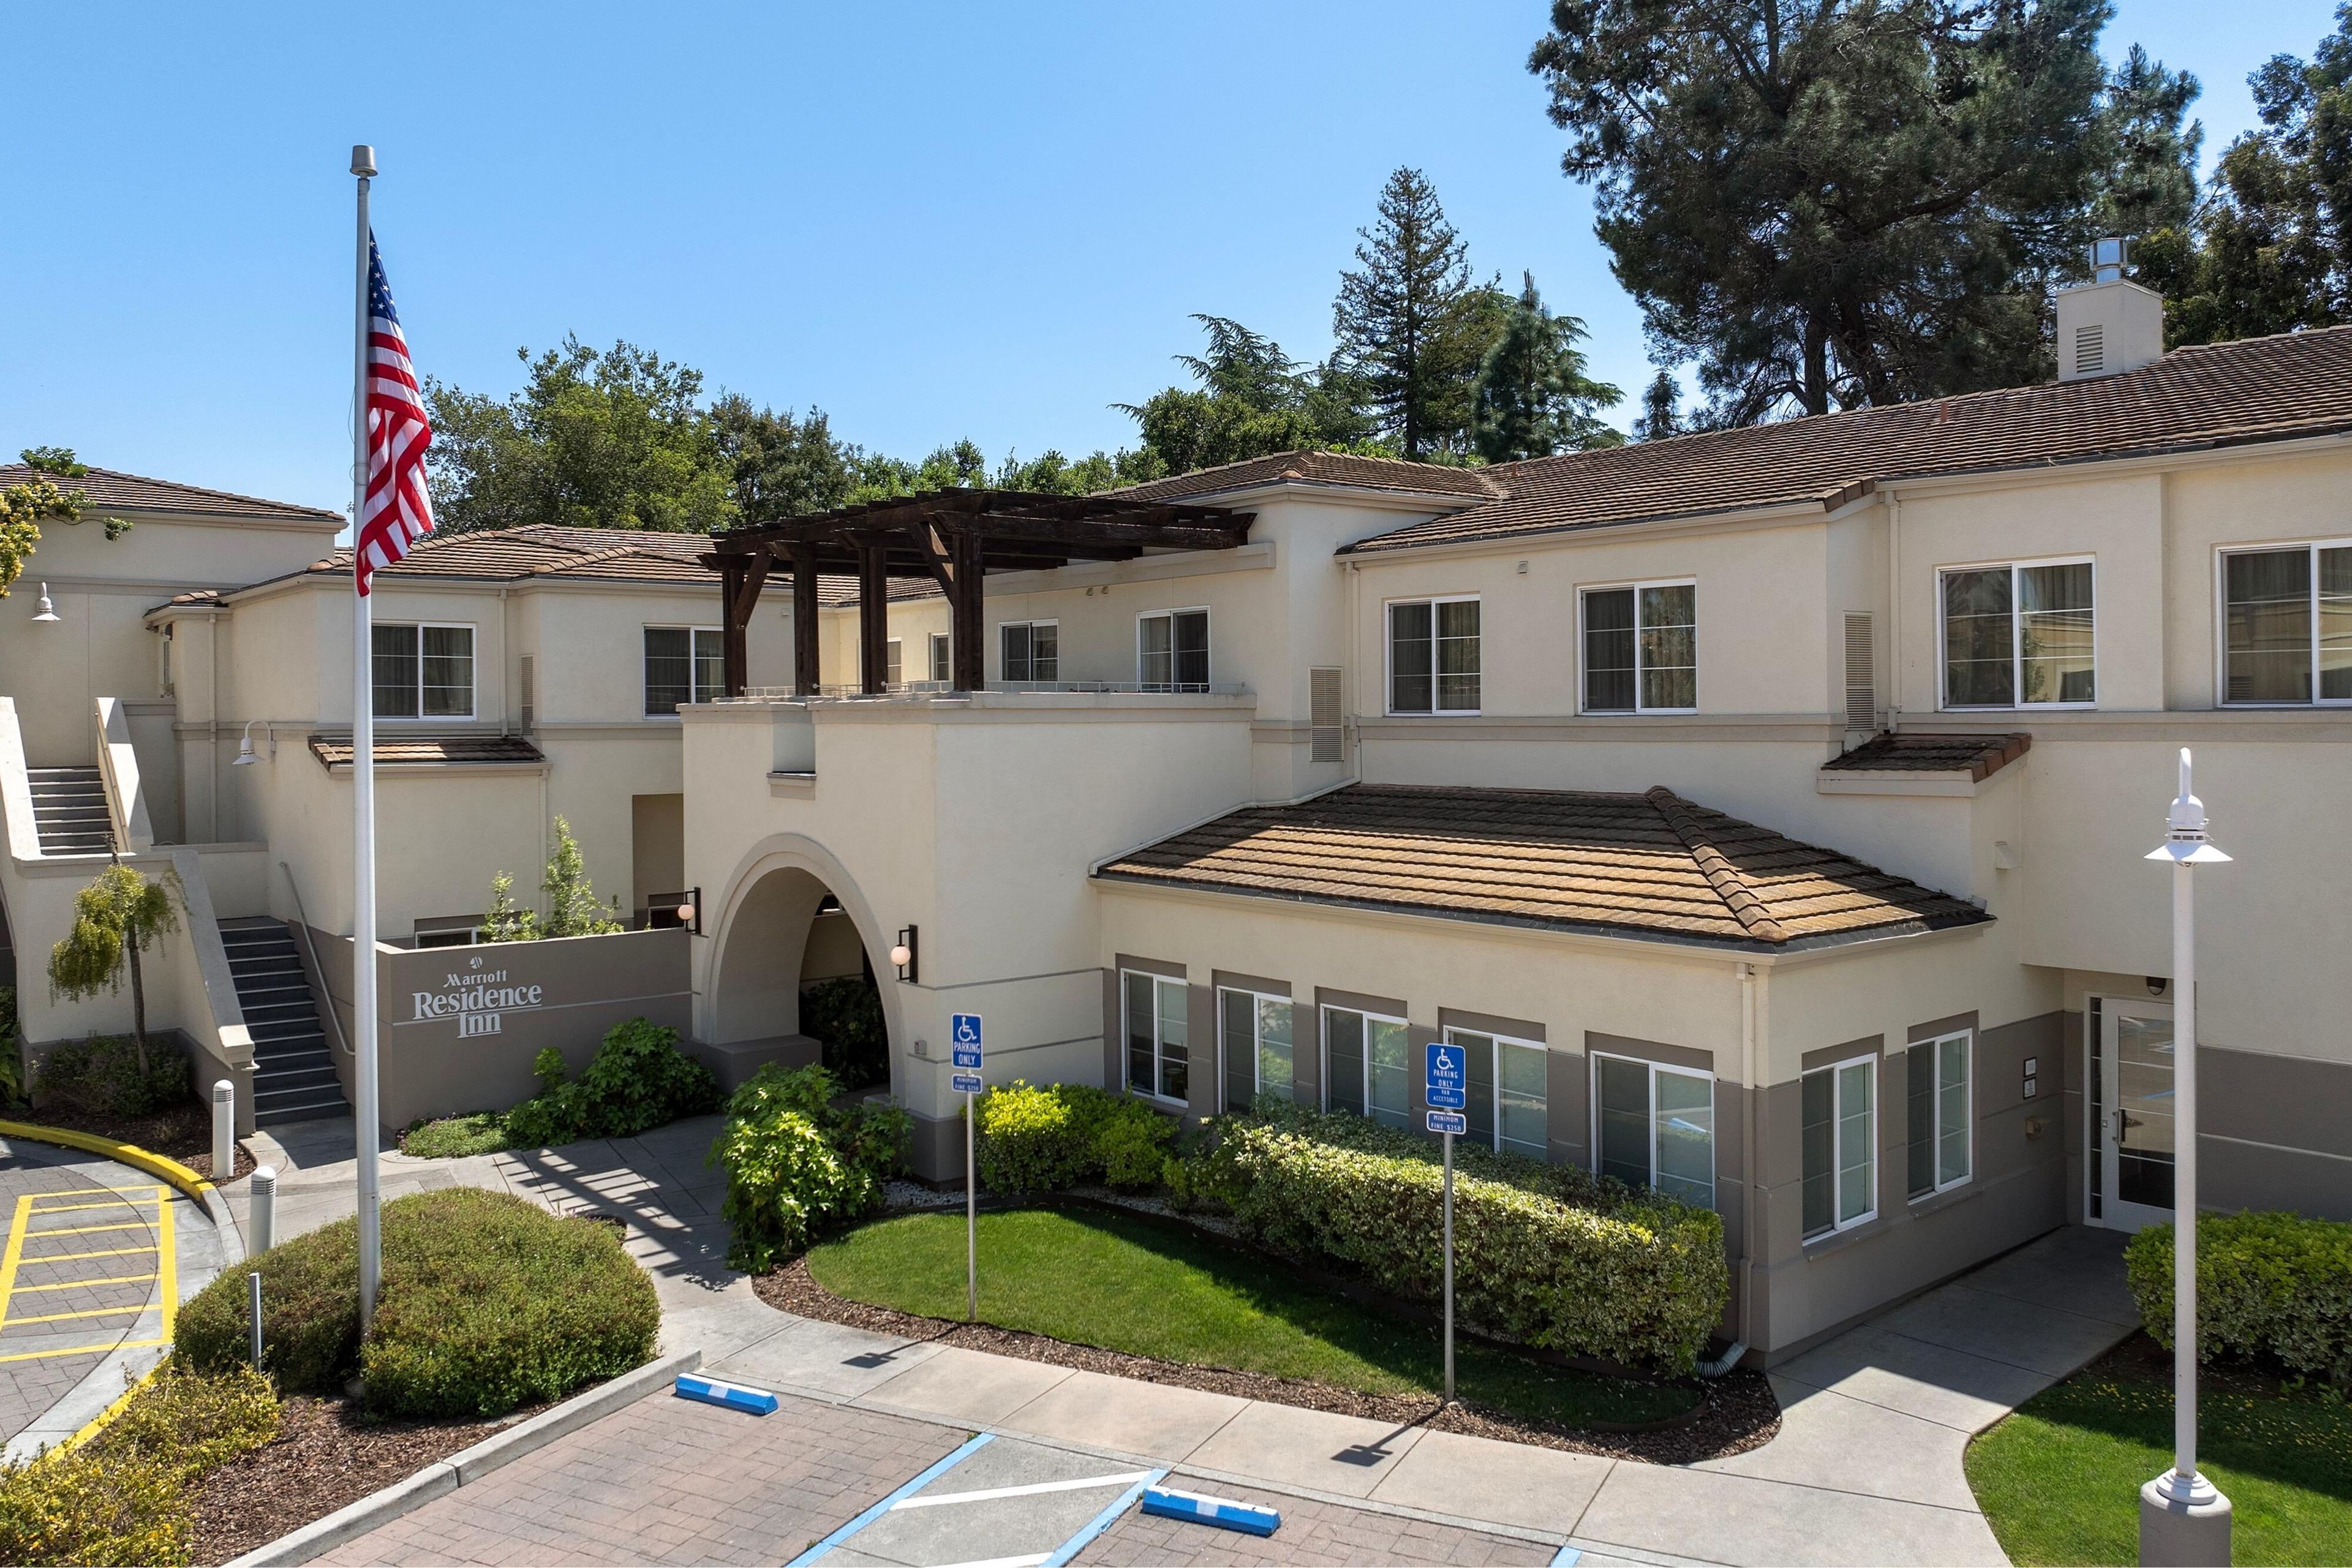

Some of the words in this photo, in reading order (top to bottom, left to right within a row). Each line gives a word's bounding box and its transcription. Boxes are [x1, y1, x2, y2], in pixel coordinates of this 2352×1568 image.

[443, 970, 507, 988] Marriott
[412, 984, 543, 1020] Residence
[458, 1011, 502, 1039] Inn
[954, 1041, 981, 1054] PARKING
[958, 1054, 976, 1065] ONLY
[1433, 1069, 1458, 1079] PARKING
[1438, 1079, 1453, 1088] ONLY
[1433, 1095, 1458, 1104] ACCESSIBLE
